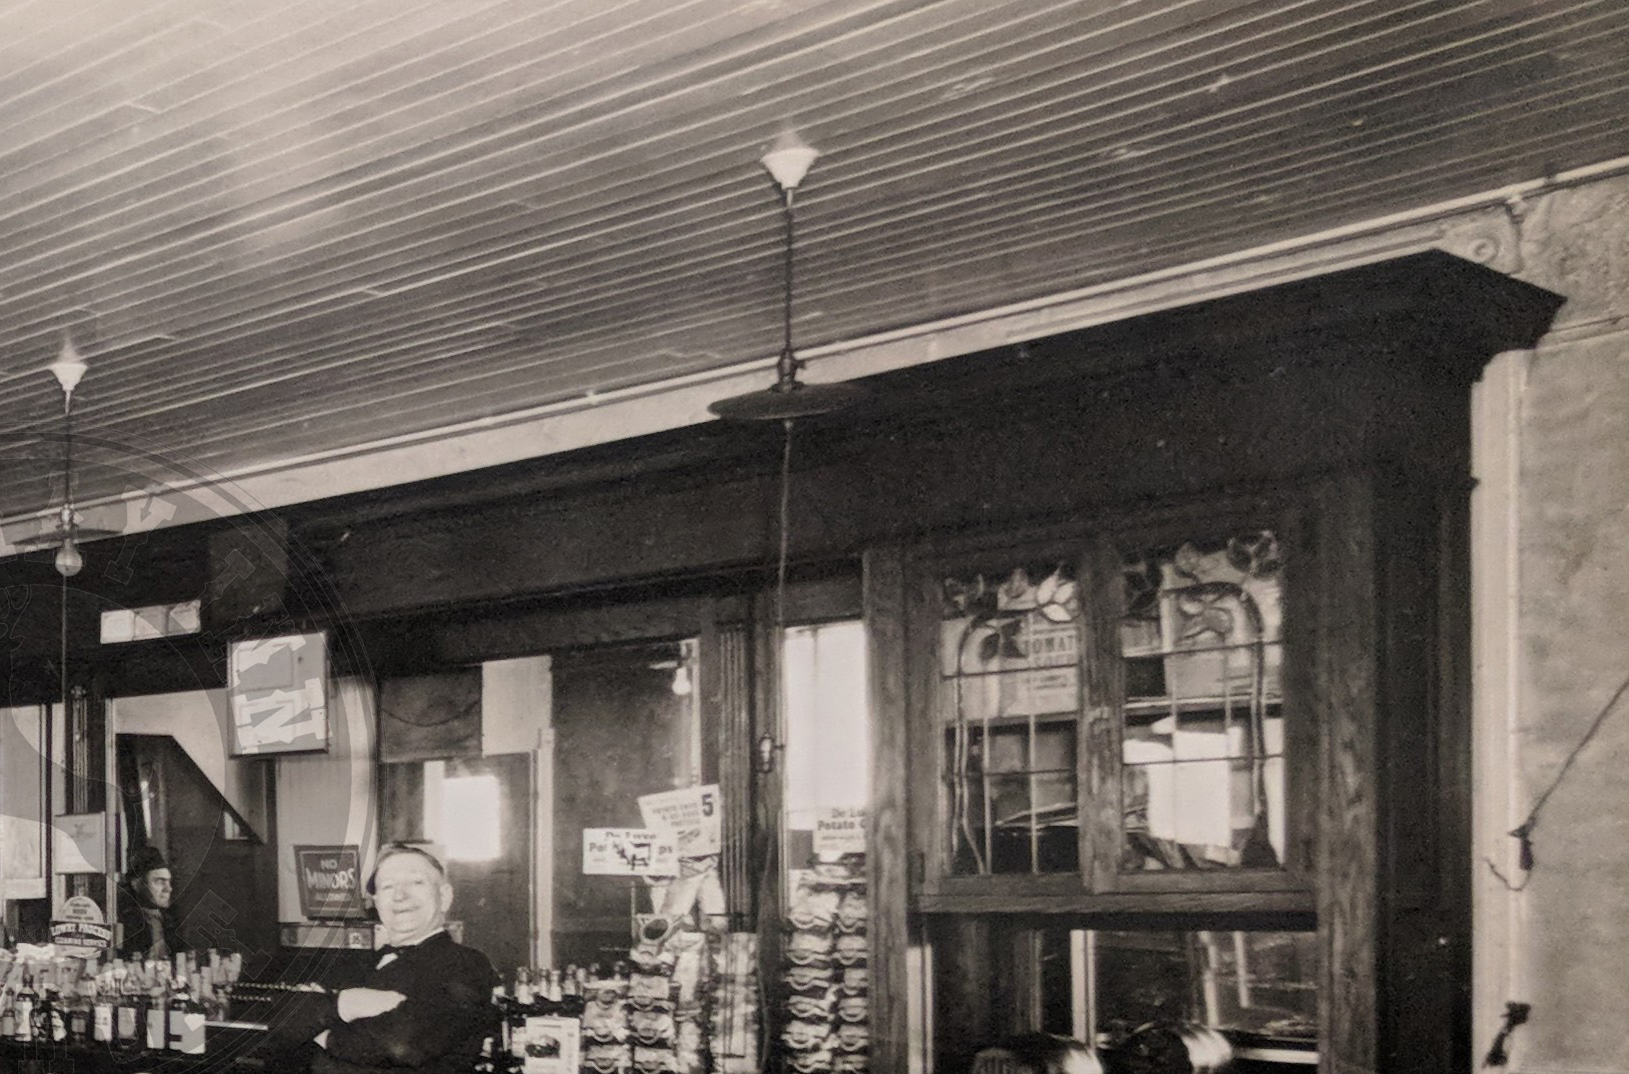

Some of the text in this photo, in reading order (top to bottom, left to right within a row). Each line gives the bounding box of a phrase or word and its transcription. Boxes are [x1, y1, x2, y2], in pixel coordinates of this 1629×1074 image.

[702, 794, 713, 816] 5
[818, 820, 855, 831] Potato
[320, 859, 338, 870] NO
[305, 867, 356, 889] MINORS
